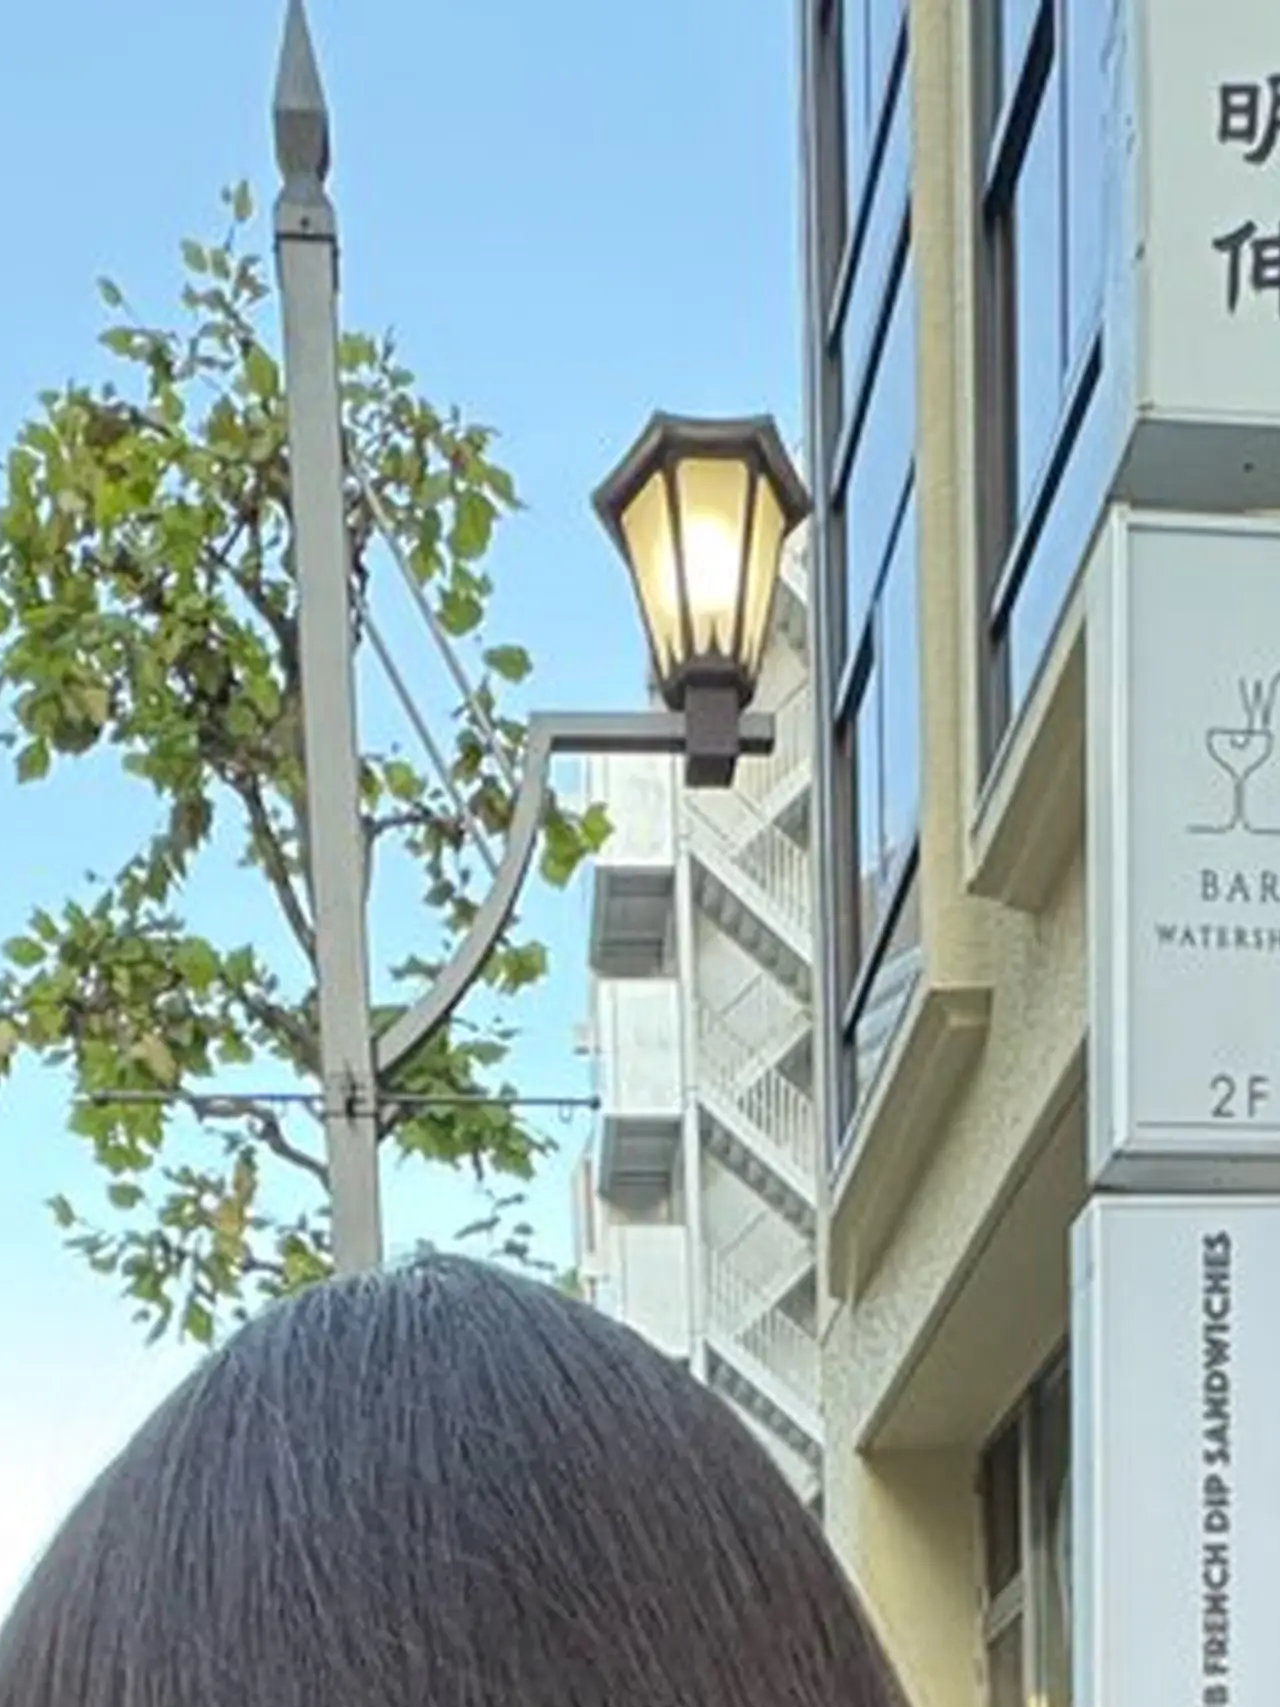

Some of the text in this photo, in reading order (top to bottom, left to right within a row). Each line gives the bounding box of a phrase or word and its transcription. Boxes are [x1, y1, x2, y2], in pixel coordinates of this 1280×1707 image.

[1209, 1073, 1271, 1119] 2F
[1202, 1229, 1232, 1467] SANDWICHES
[1202, 1472, 1232, 1534] DIP
[1202, 1542, 1231, 1676] FRENCH
